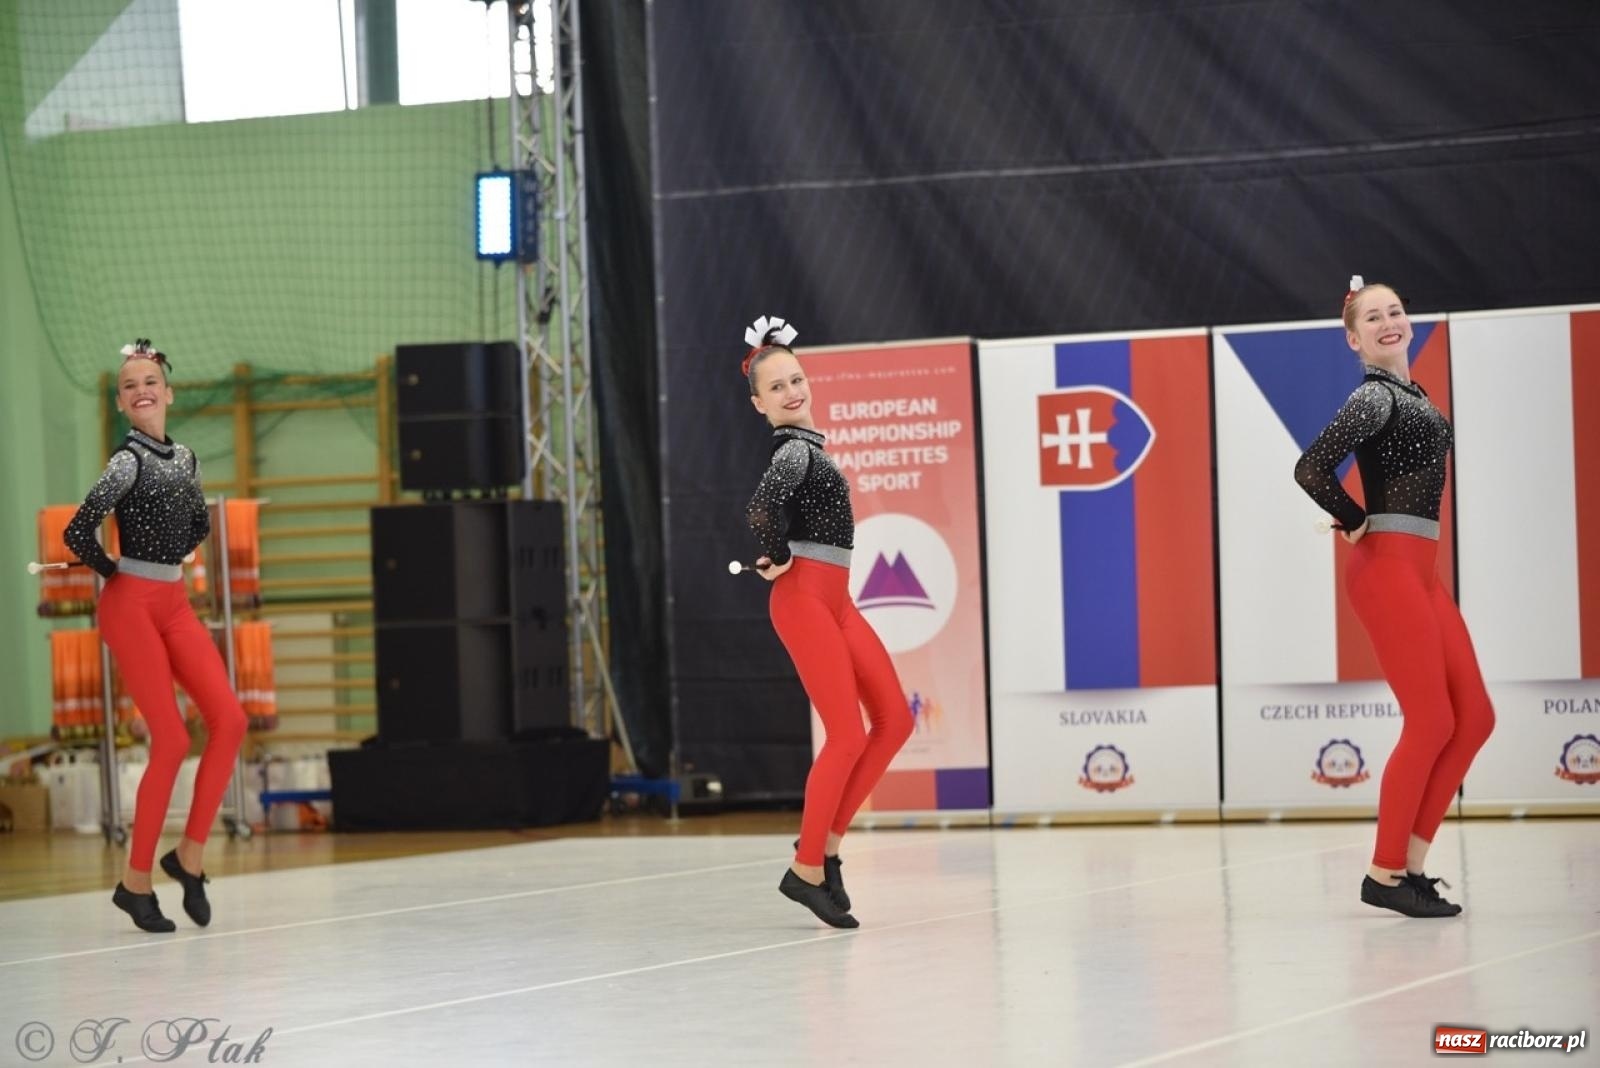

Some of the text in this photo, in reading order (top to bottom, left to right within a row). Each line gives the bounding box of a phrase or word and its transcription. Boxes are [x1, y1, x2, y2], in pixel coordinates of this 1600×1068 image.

[829, 398, 937, 421] EUROPEAN
[823, 421, 961, 446] HAMPIONSHIP
[857, 472, 922, 493] SPORT
[1059, 709, 1147, 726] SLOVAKIA
[1260, 704, 1319, 720] CZECH
